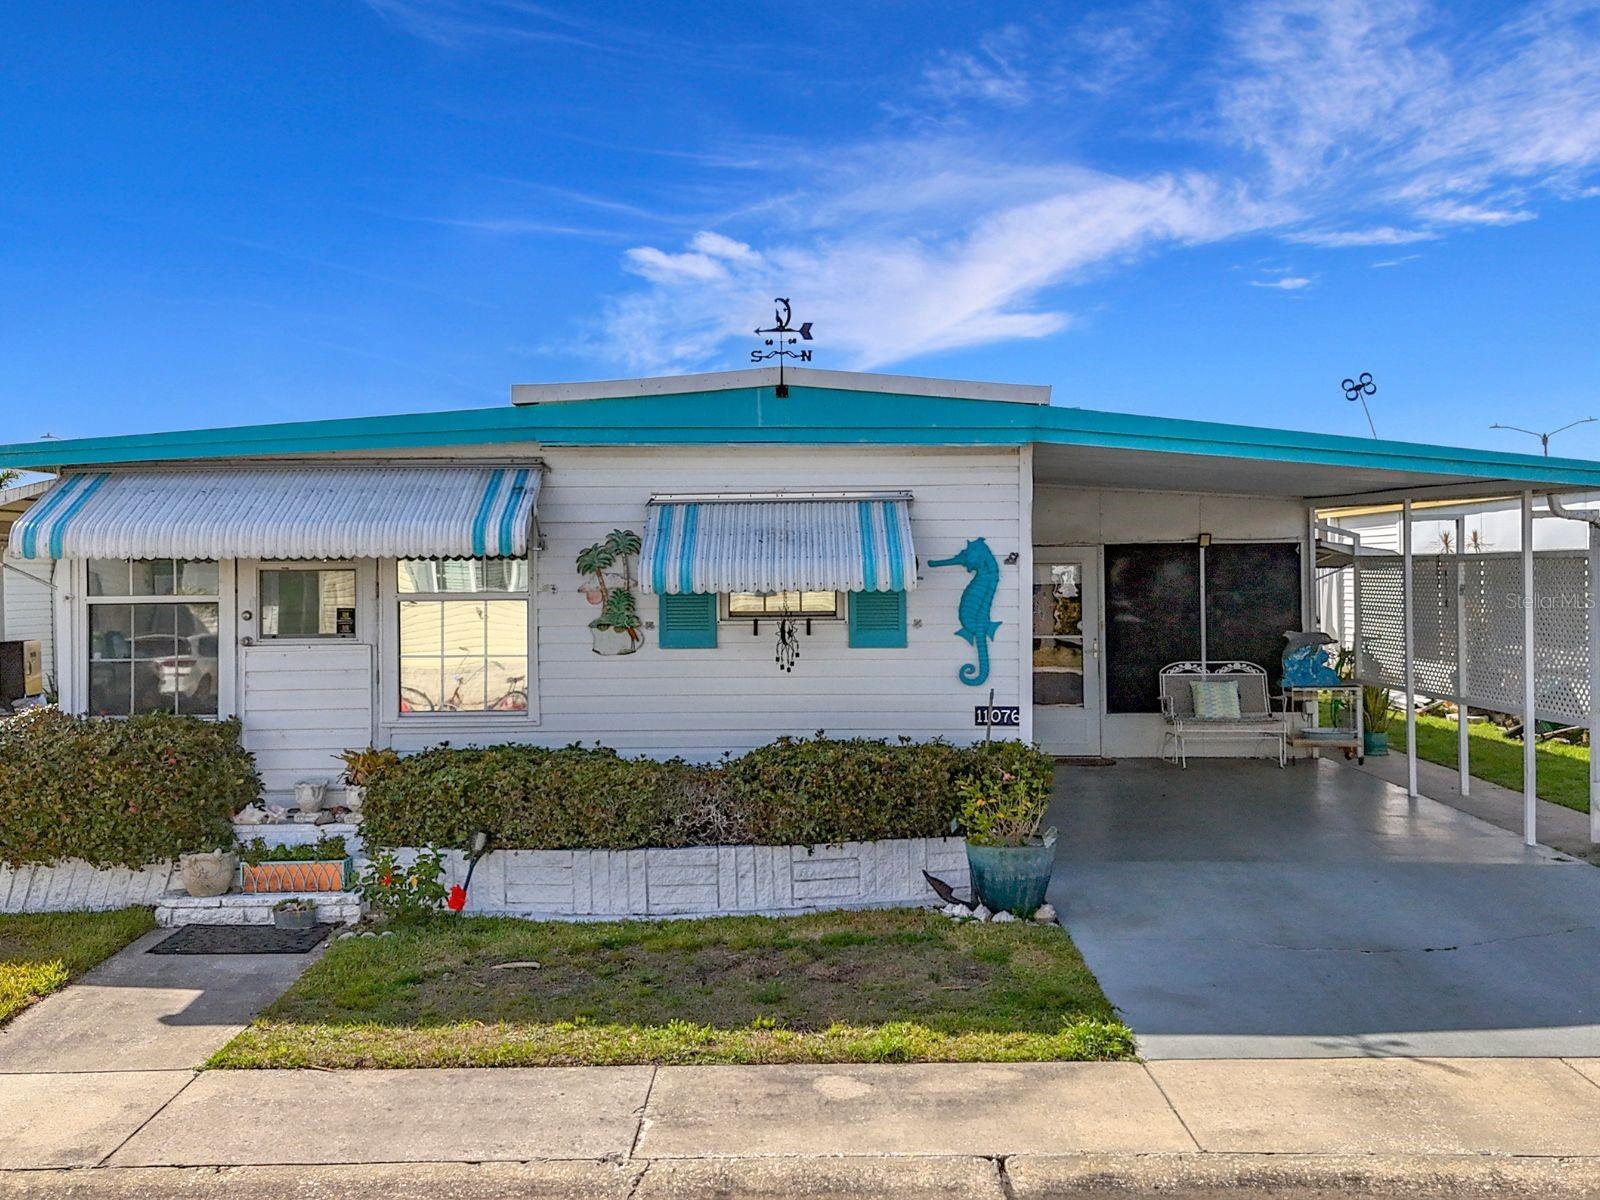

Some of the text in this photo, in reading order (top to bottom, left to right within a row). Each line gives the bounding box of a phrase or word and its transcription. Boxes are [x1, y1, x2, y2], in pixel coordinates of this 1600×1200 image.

[751, 350, 812, 362] S N
[976, 709, 1019, 723] 11076
